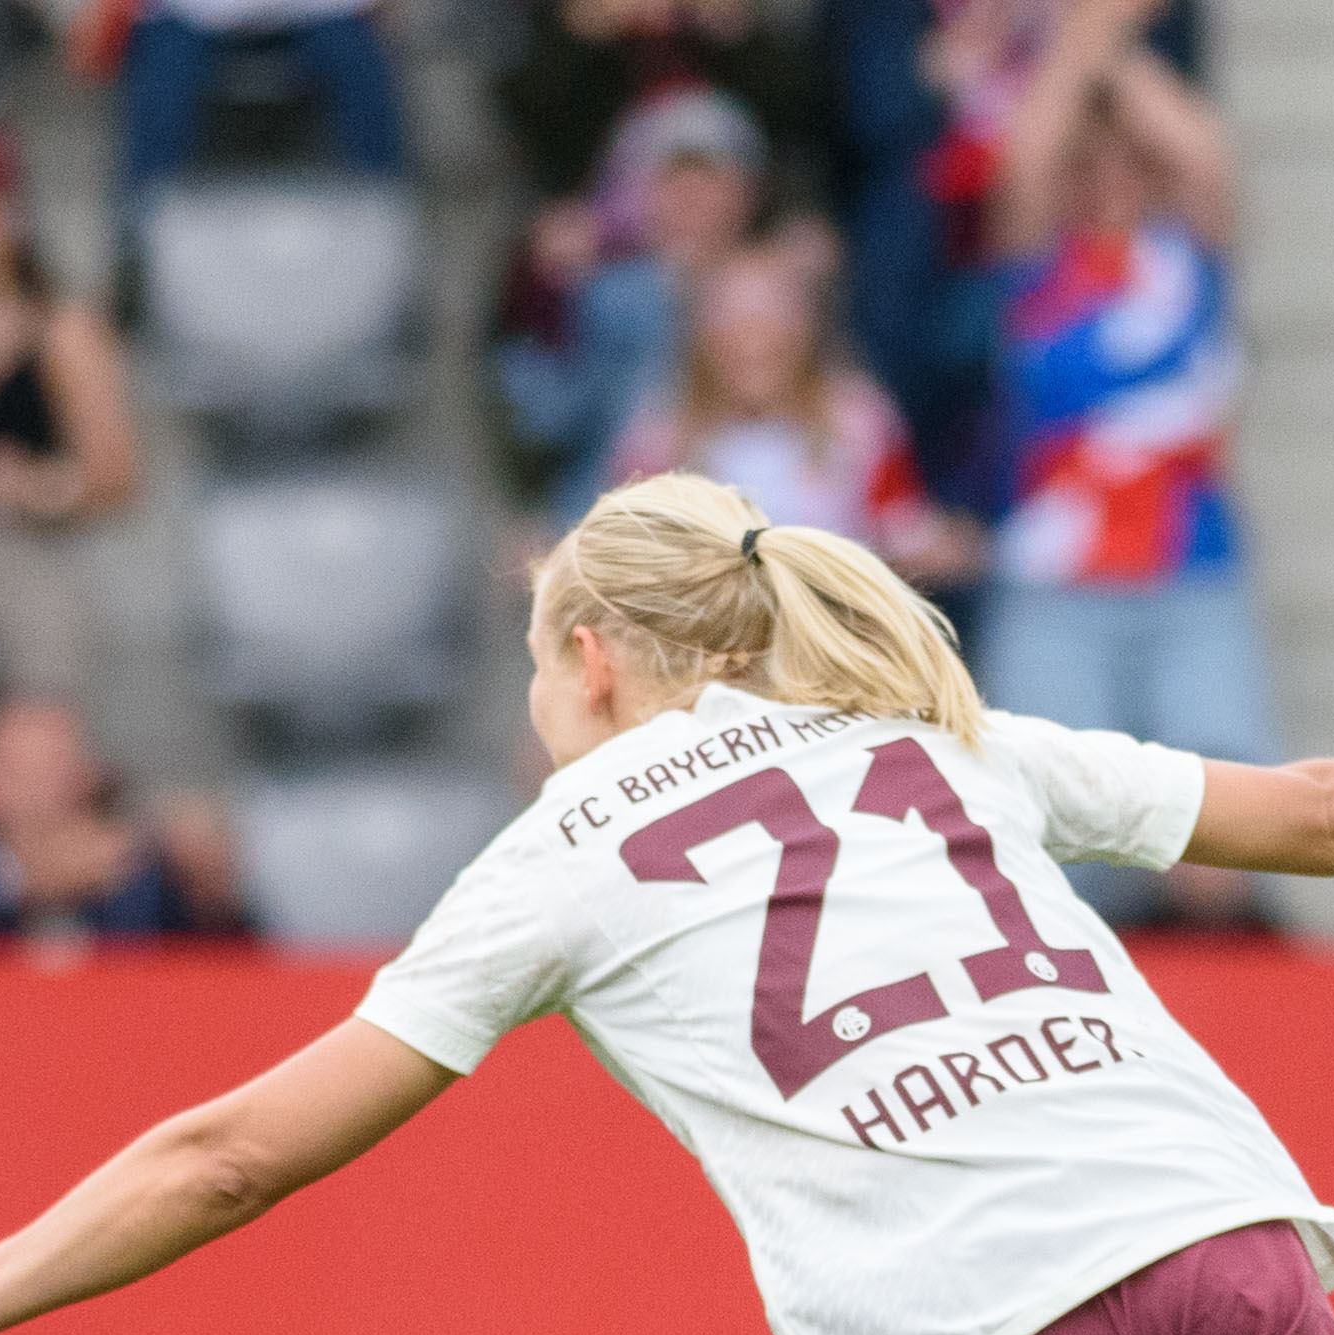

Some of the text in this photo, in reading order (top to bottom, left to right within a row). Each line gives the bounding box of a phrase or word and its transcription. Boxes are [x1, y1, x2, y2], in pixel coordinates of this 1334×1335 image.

[558, 796, 612, 848] FC
[617, 714, 783, 805] BAYERN
[618, 736, 1112, 1102] 21
